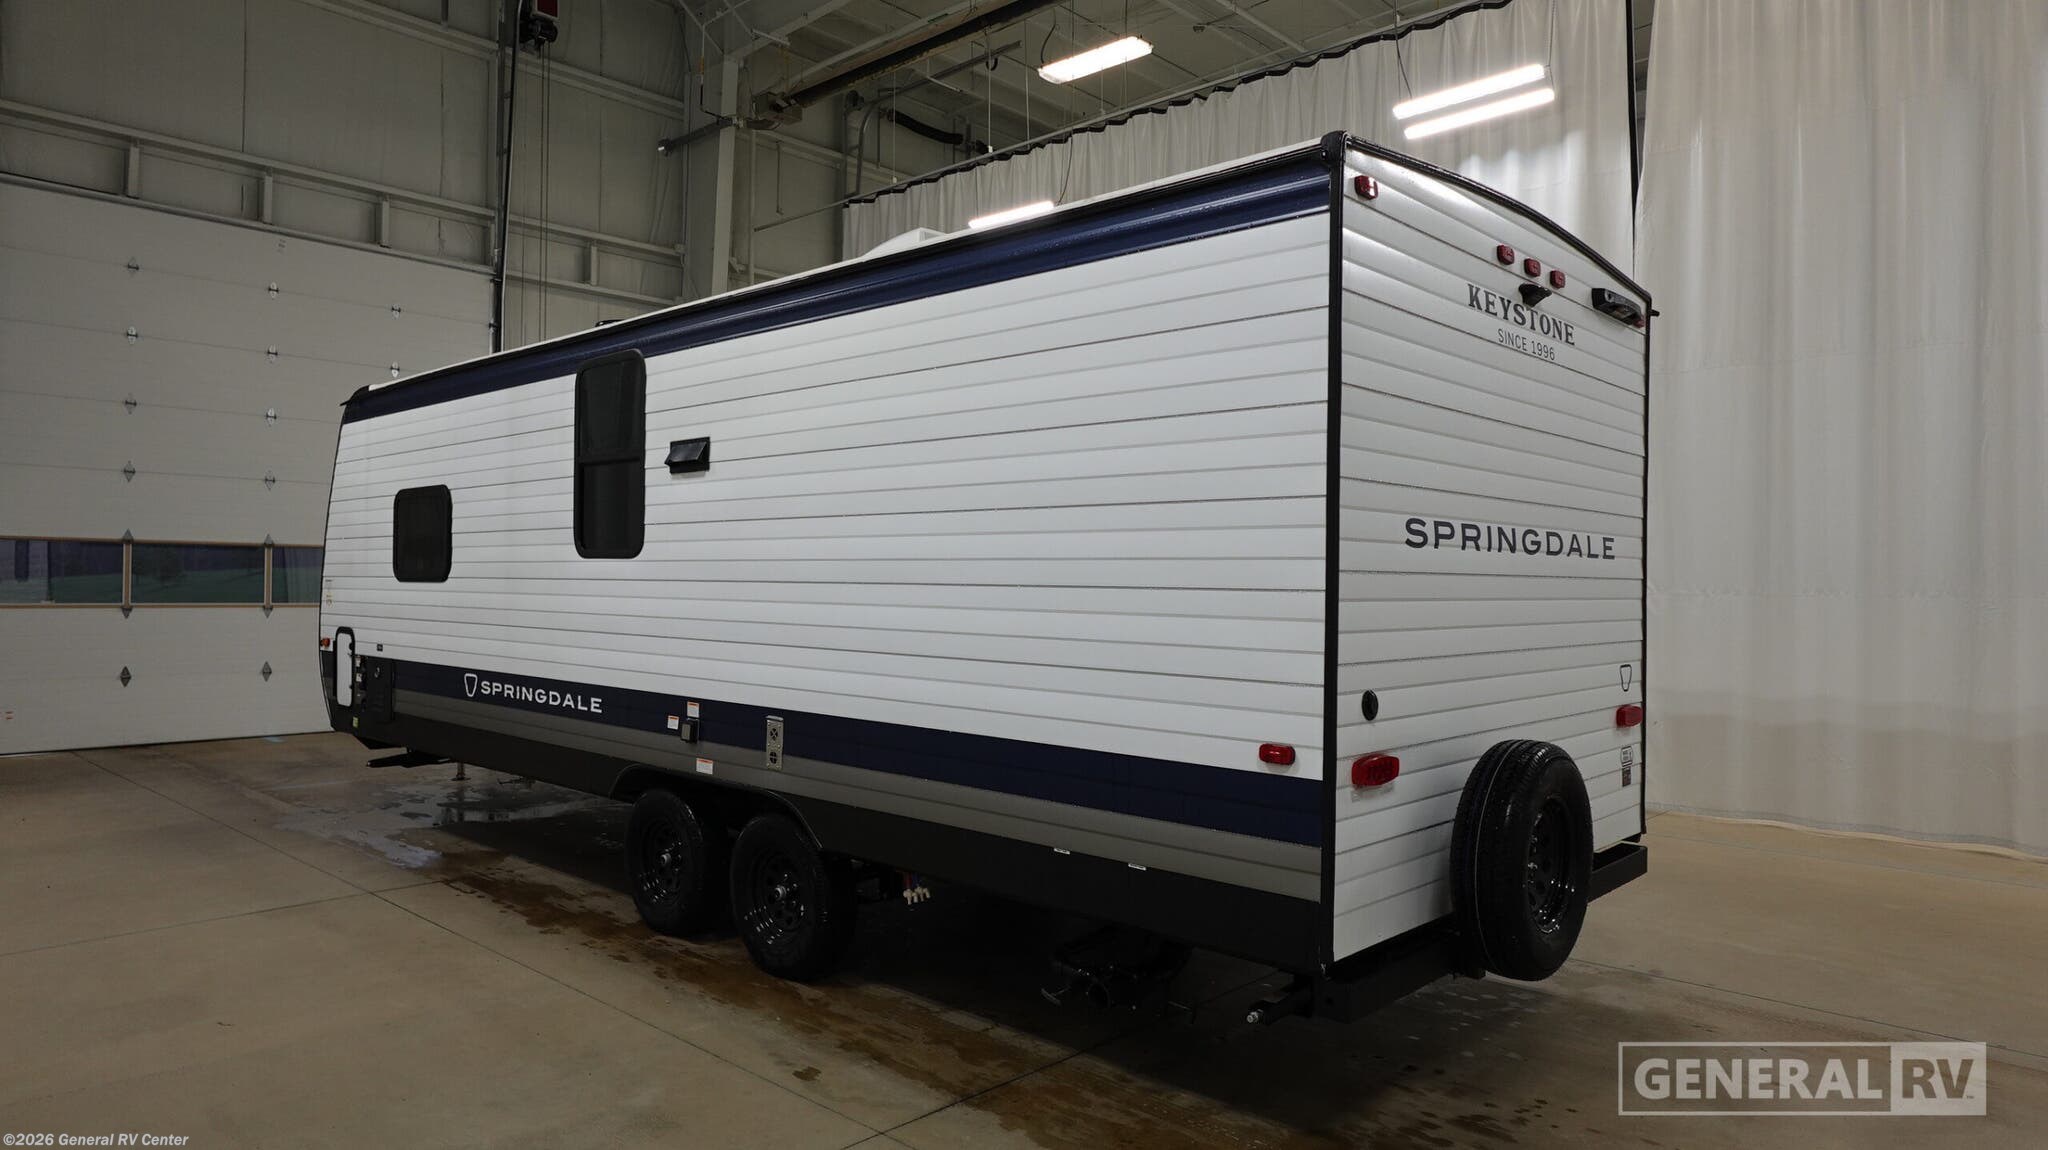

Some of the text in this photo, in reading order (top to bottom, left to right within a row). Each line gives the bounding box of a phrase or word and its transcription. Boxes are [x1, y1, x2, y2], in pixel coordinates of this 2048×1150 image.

[1467, 283, 1576, 346] KEYSTONE
[1498, 328, 1556, 361] SINCE 1996
[1405, 517, 1616, 560] SPRINGDALE
[480, 680, 603, 714] SPRINGDALE
